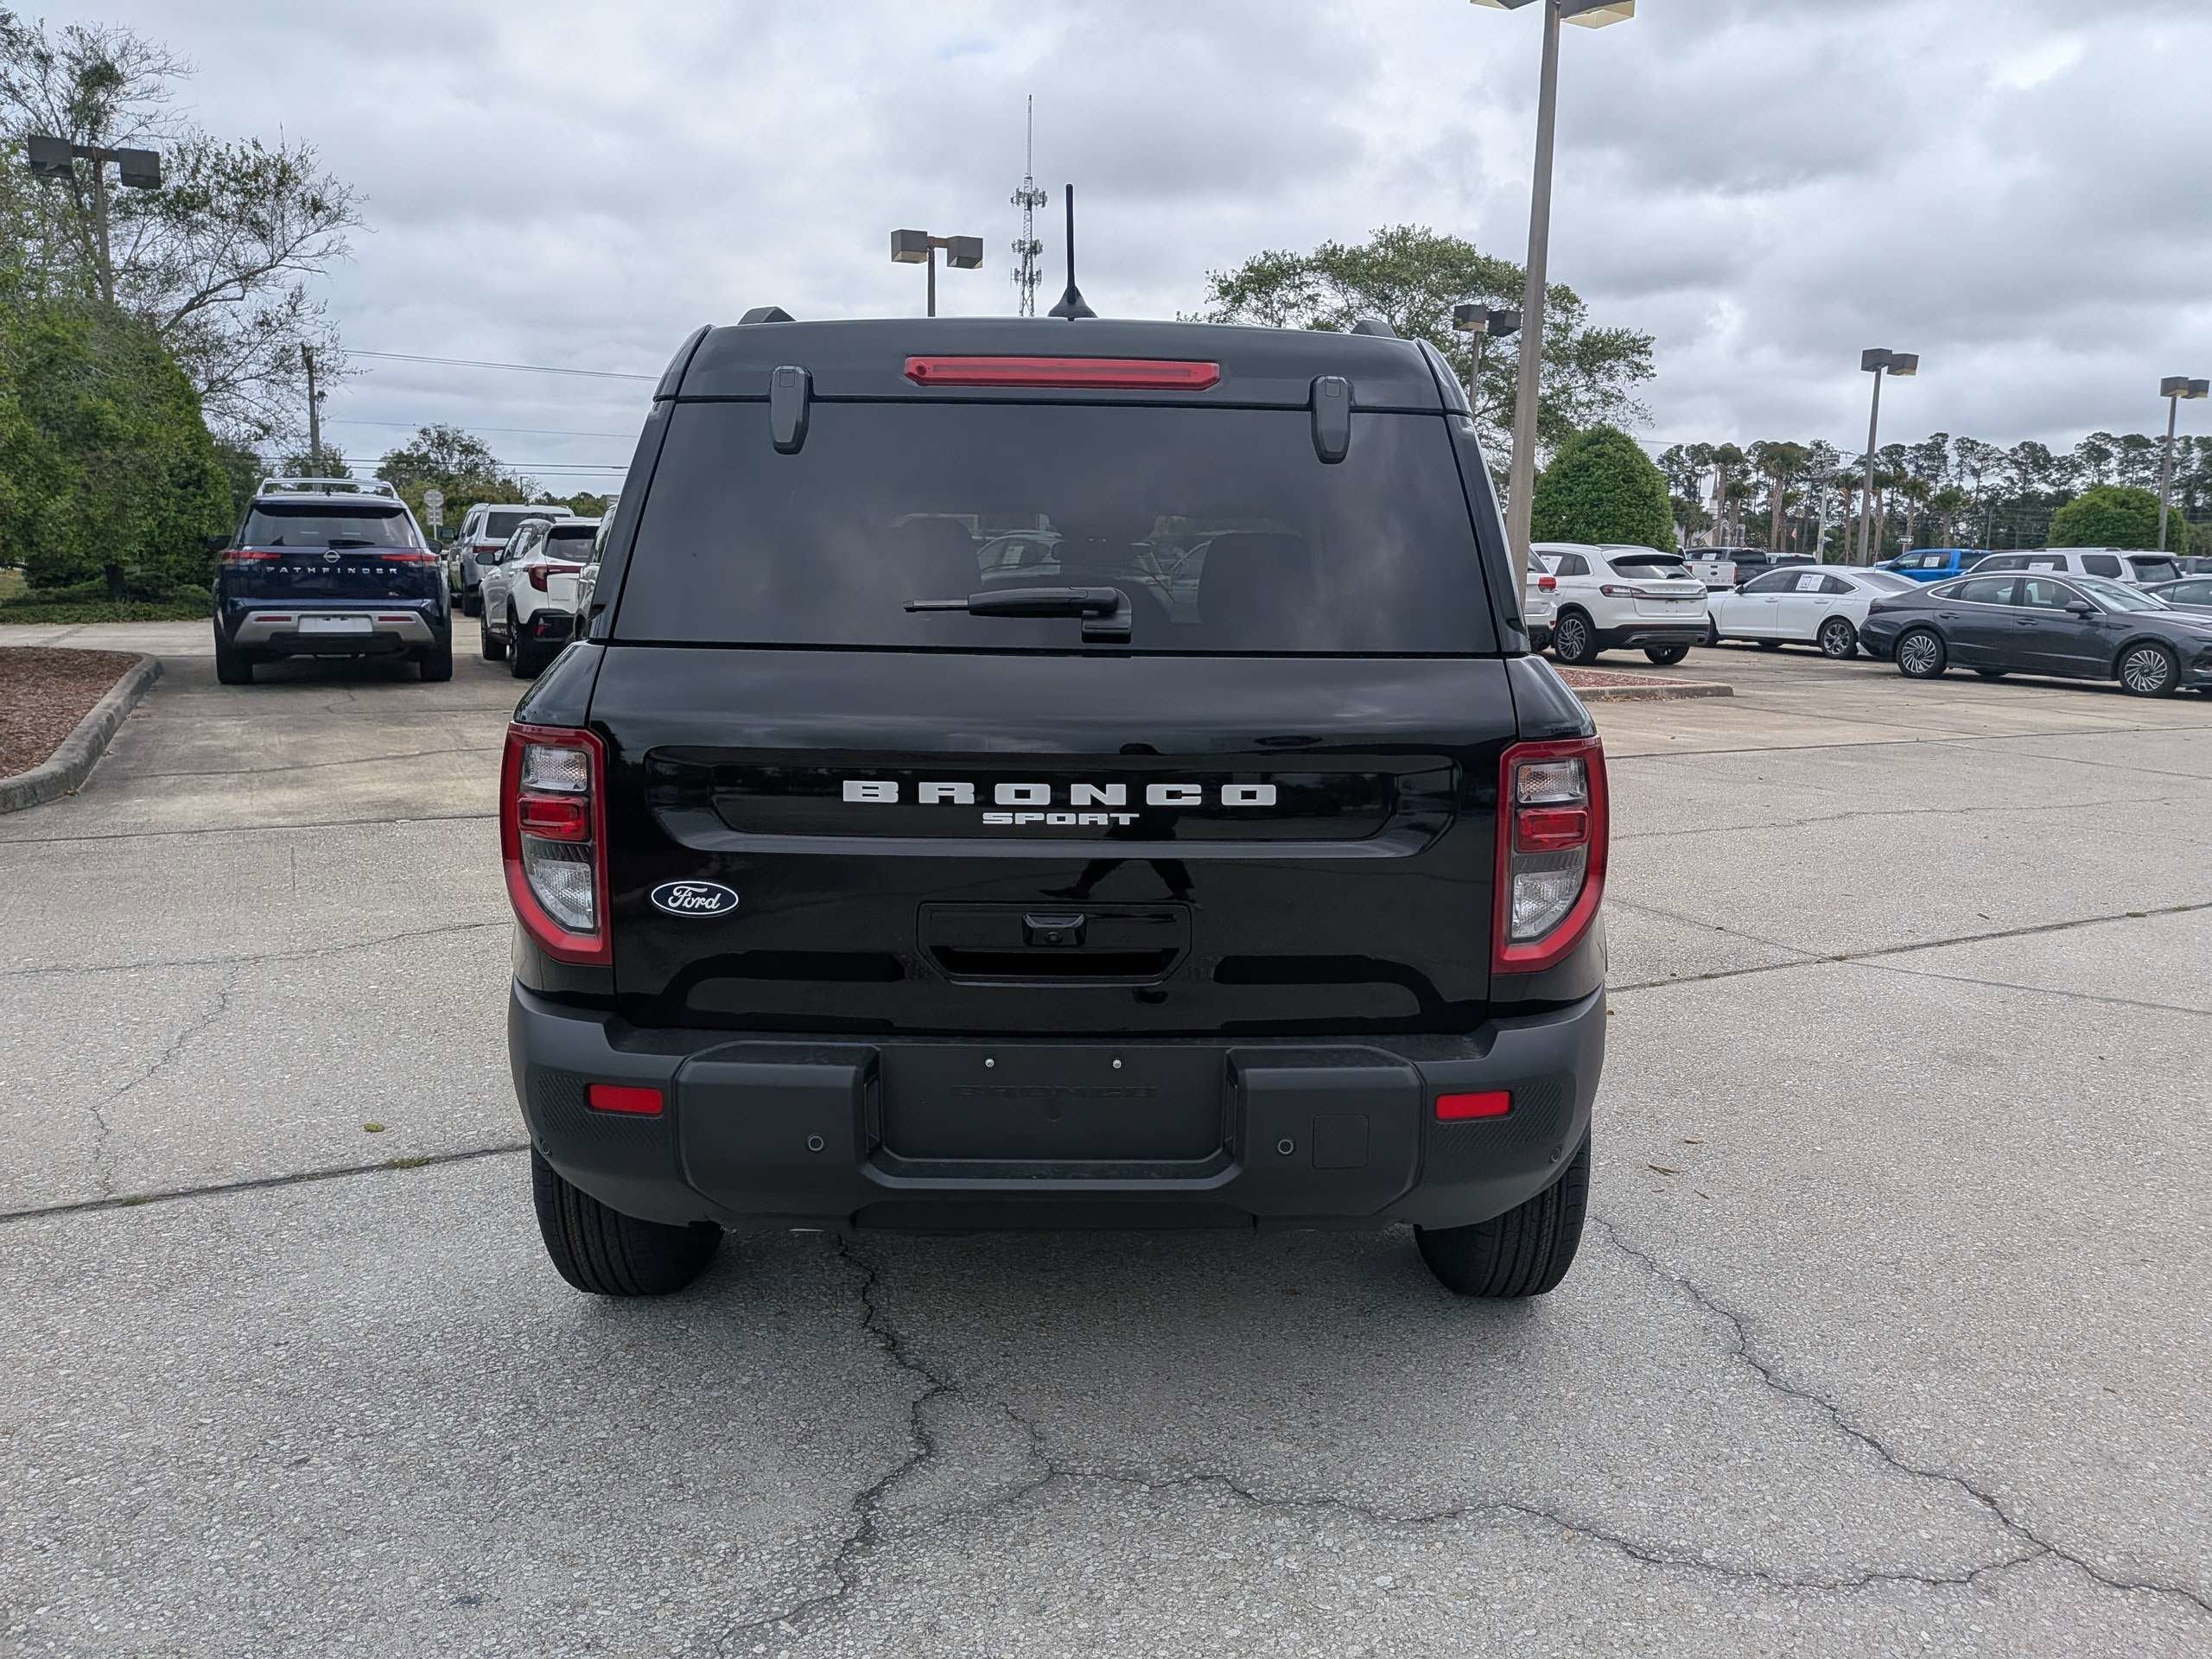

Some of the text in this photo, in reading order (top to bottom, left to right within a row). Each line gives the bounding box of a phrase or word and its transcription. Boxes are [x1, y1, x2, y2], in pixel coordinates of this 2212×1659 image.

[842, 780, 1277, 806] BRONCO
[982, 812, 1140, 825] SPORT
[668, 886, 721, 910] Ford
